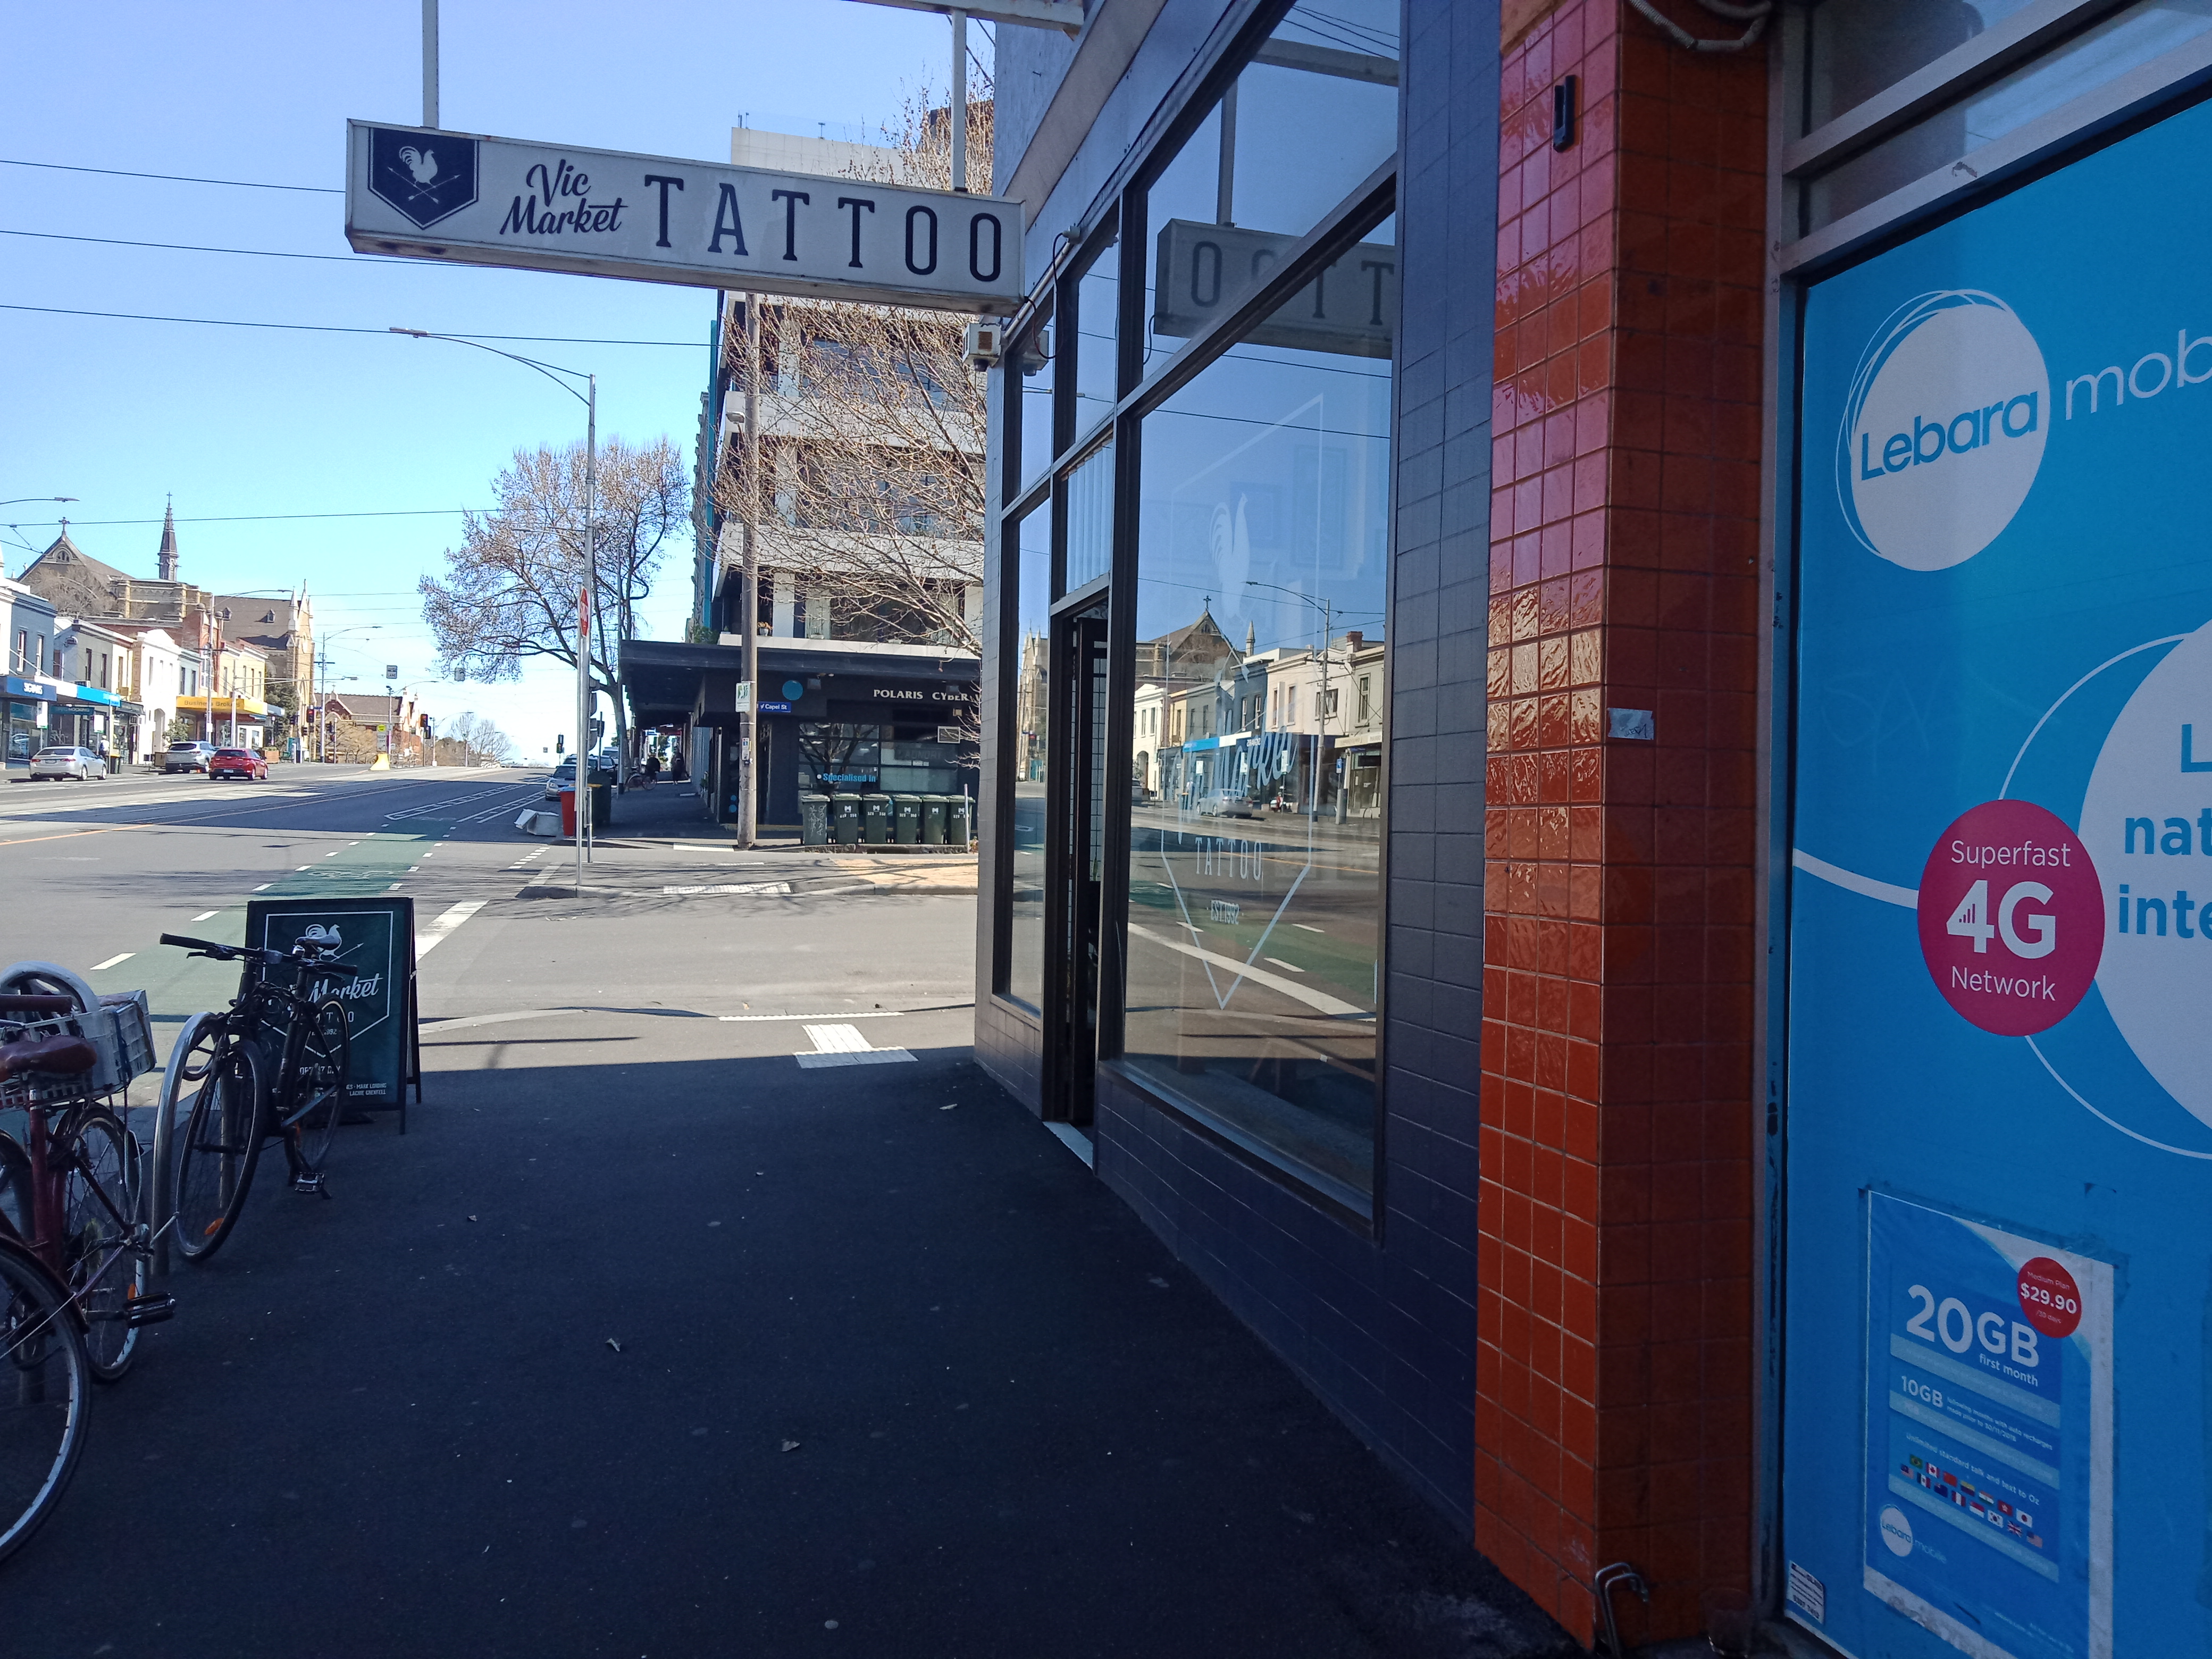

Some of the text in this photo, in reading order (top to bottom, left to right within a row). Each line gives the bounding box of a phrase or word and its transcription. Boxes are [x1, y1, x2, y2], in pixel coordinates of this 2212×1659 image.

[526, 160, 591, 206] Vic
[500, 196, 628, 234] Market
[644, 174, 1001, 282] TATTOO
[1861, 329, 2212, 481] Lebara mob
[874, 690, 923, 699] POLARIS
[2125, 808, 2212, 856] nat
[1195, 837, 1261, 881] TATTOO
[1951, 840, 2071, 869] Superfast
[1946, 879, 2056, 959] 4G
[1951, 966, 2056, 1001] Network
[2021, 1283, 2077, 1314] $29.90
[2027, 1271, 2070, 1290] Medium Plan
[1906, 1285, 2040, 1367] 20GB
[2048, 1315, 2062, 1323] days
[1980, 1353, 2038, 1387] first month
[1901, 1376, 1943, 1408] 10GB
[1995, 1420, 2007, 1428] with
[1939, 1450, 1969, 1469] standard
[1971, 1465, 1984, 1477] talk
[1986, 1474, 2000, 1485] and
[2018, 1488, 2026, 1498] to
[2029, 1494, 2040, 1505] Oz
